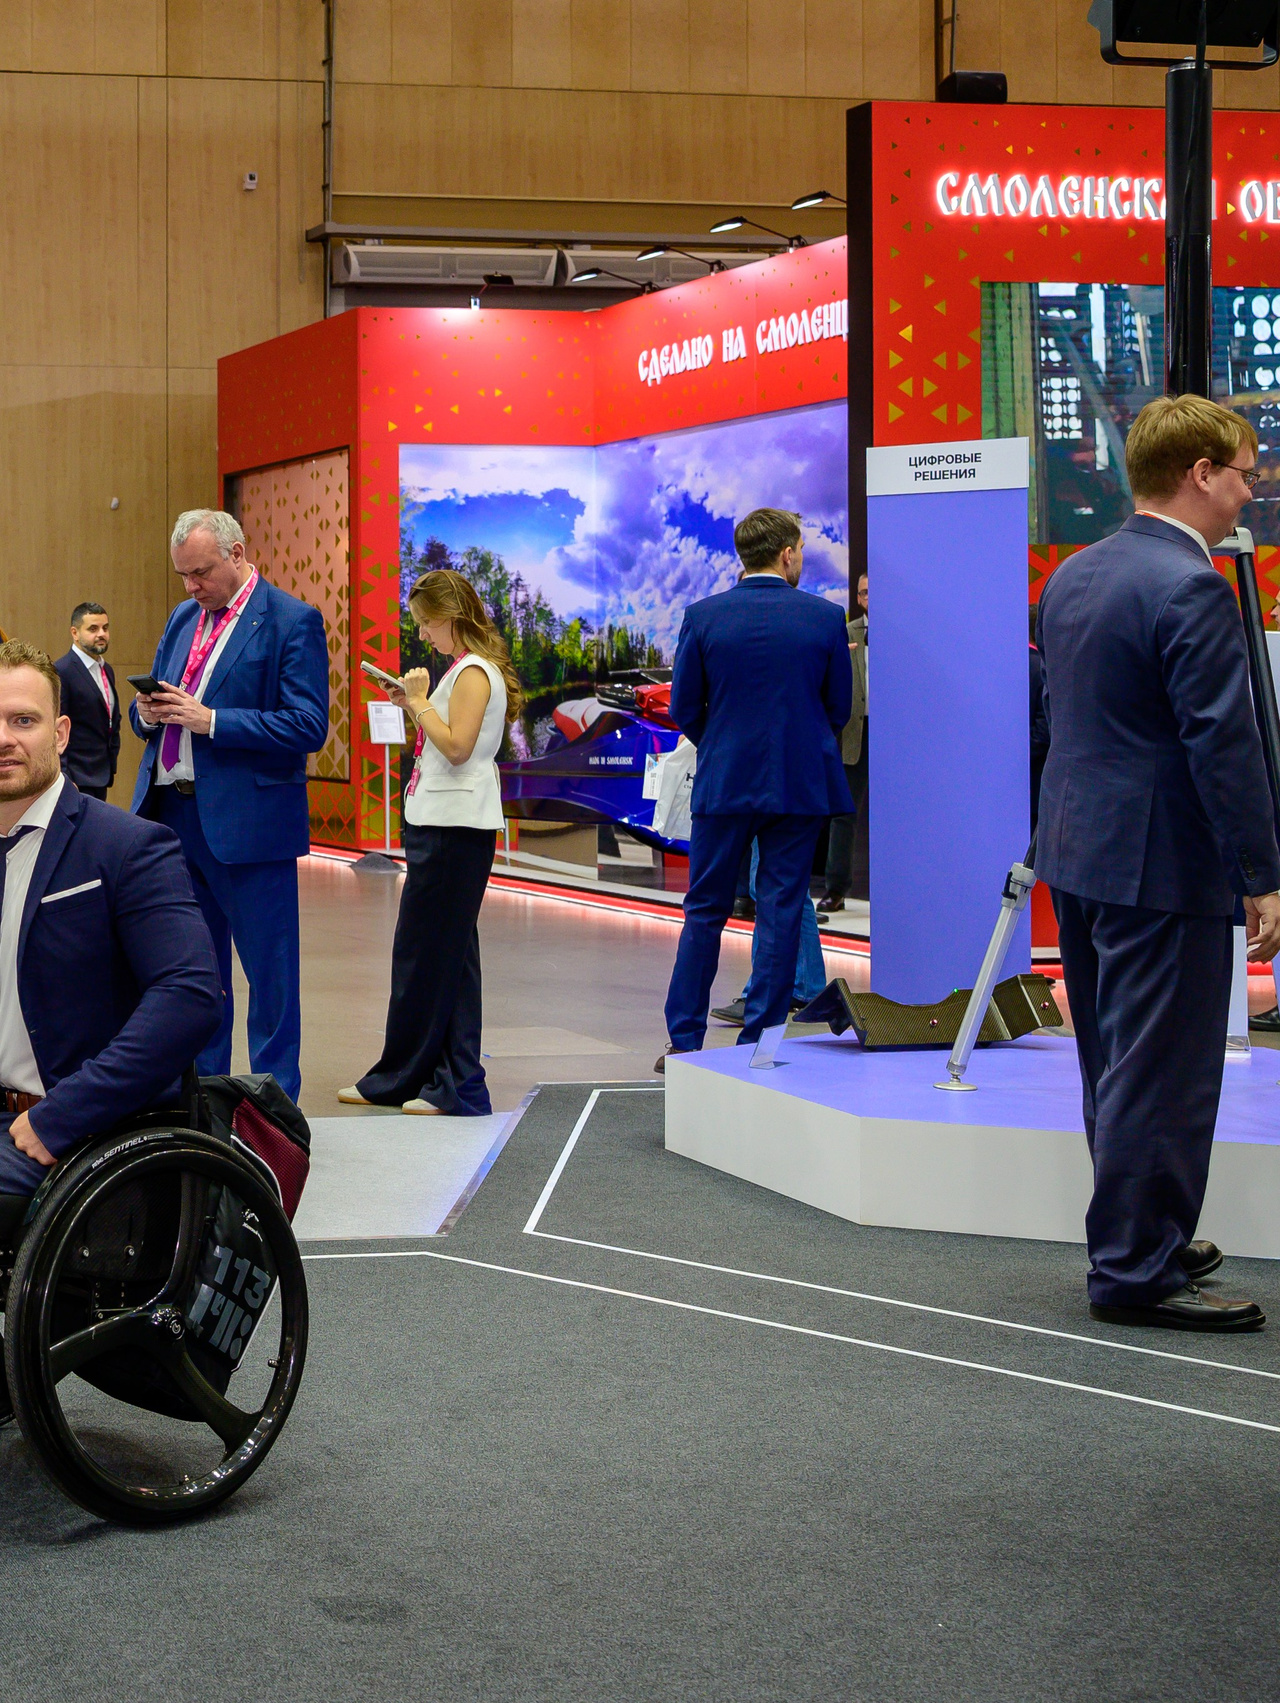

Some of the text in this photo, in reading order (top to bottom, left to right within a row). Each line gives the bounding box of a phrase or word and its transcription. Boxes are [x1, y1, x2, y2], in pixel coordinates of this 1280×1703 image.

[936, 171, 1217, 221] СМОЛЕНСК
[637, 334, 714, 387] СДЕЛАНО
[722, 325, 747, 363] НА
[908, 452, 982, 468] ЦИФРОВЫЕ
[914, 468, 976, 481] РЕШЕНИЯ
[104, 1136, 145, 1160] SENTINEL
